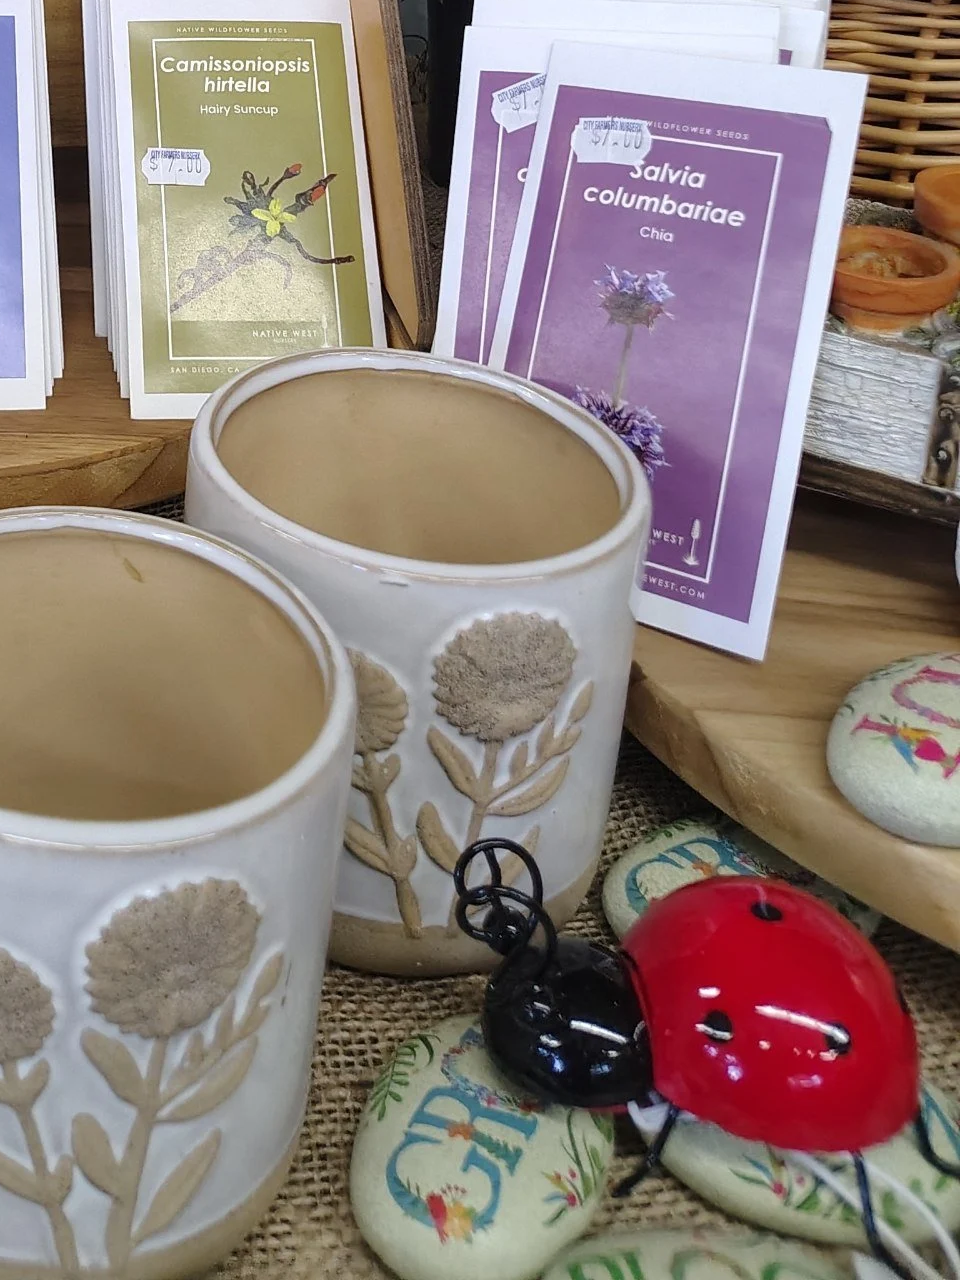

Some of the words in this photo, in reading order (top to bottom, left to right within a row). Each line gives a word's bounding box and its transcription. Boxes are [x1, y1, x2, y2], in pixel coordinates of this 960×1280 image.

[160, 56, 310, 75] Camissoniopsis
[204, 77, 270, 93] hirtella
[200, 104, 230, 116] Hairy
[233, 104, 279, 116] Suncup
[646, 120, 712, 135] WILDFLOWER
[715, 129, 749, 140] SEEDS
[629, 161, 706, 189] Salvia
[583, 186, 746, 227] columbariae
[639, 226, 674, 243] Chia
[252, 329, 288, 338] NATIVE
[293, 329, 318, 337] WEST
[652, 528, 685, 546] WEST
